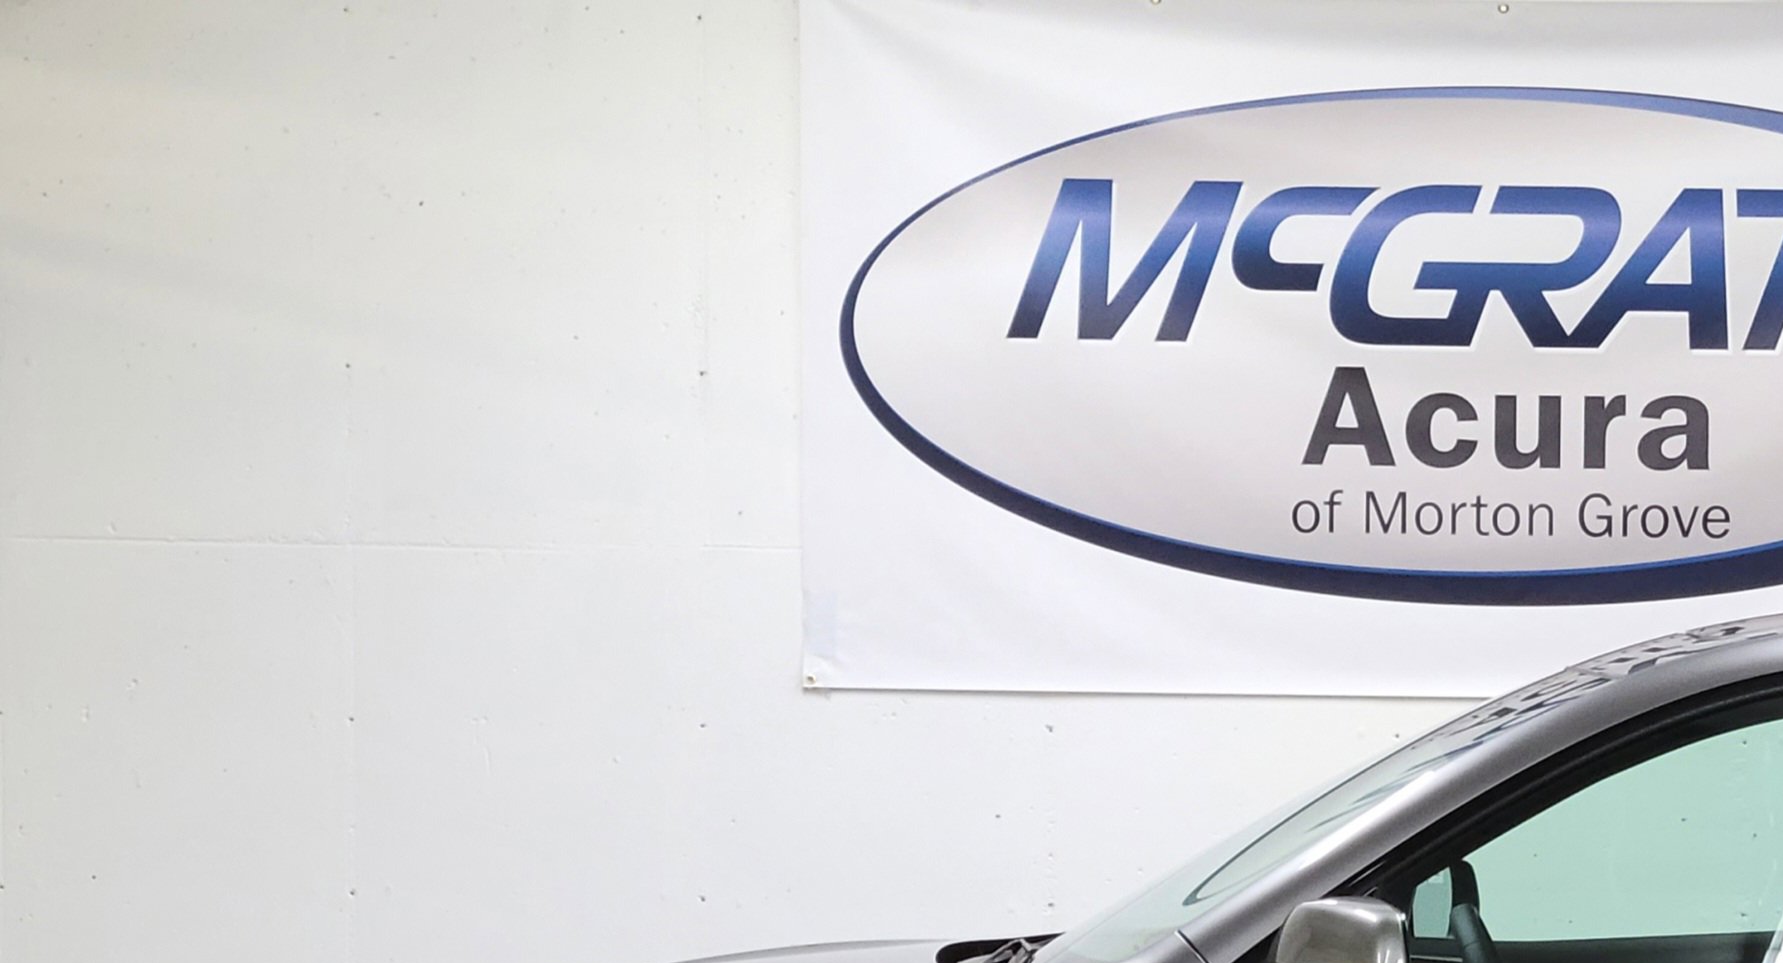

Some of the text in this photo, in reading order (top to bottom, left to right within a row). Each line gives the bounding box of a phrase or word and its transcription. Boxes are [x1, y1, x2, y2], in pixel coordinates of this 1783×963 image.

[1301, 366, 1711, 470] Acura
[1291, 489, 1731, 540] of Morton Grove
